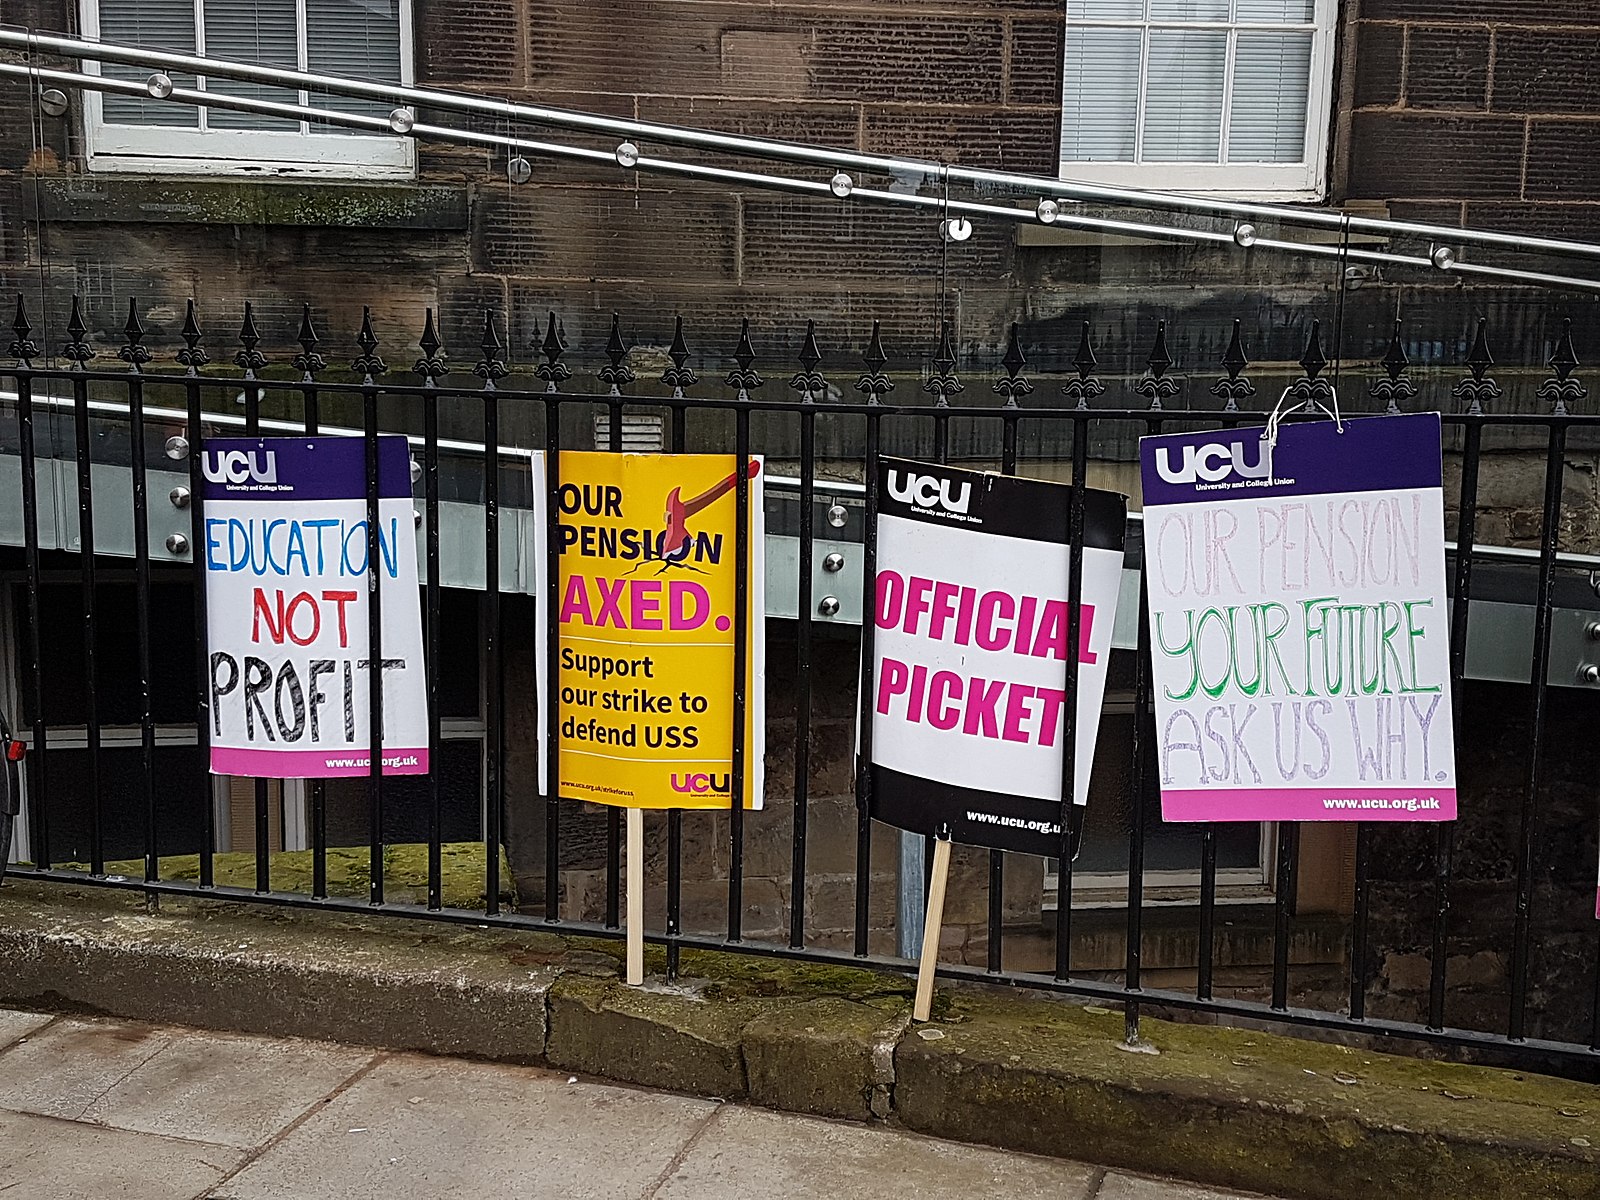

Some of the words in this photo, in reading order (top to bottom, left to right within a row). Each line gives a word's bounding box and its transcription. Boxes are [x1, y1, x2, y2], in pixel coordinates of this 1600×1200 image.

[559, 483, 623, 518] OUR
[1196, 481, 1230, 491] University
[1274, 478, 1295, 486] Union
[967, 516, 982, 524] Union
[206, 517, 398, 578] EDUCATION
[559, 525, 723, 565] PENSION
[1157, 508, 1247, 598] OUR
[1257, 494, 1422, 594] PENSION
[252, 588, 357, 648] NOT
[560, 575, 731, 631] AXED.
[875, 569, 1098, 665] OFFICIAL
[561, 648, 654, 680] Support
[1154, 600, 1300, 700] YOUR
[1296, 596, 1442, 697] FUTURE
[210, 652, 406, 743] PROFIT
[561, 687, 597, 707] our
[602, 688, 672, 713] strike
[679, 692, 708, 713] to
[876, 656, 1067, 748] PICKET
[561, 716, 636, 747] defend
[645, 726, 699, 748] USS
[1162, 704, 1263, 785] ASK
[1272, 700, 1333, 781] US
[1346, 694, 1448, 783] WHY.
[325, 756, 418, 768] www.ucorg.uk
[1323, 797, 1440, 811] www.ucu.org.uk
